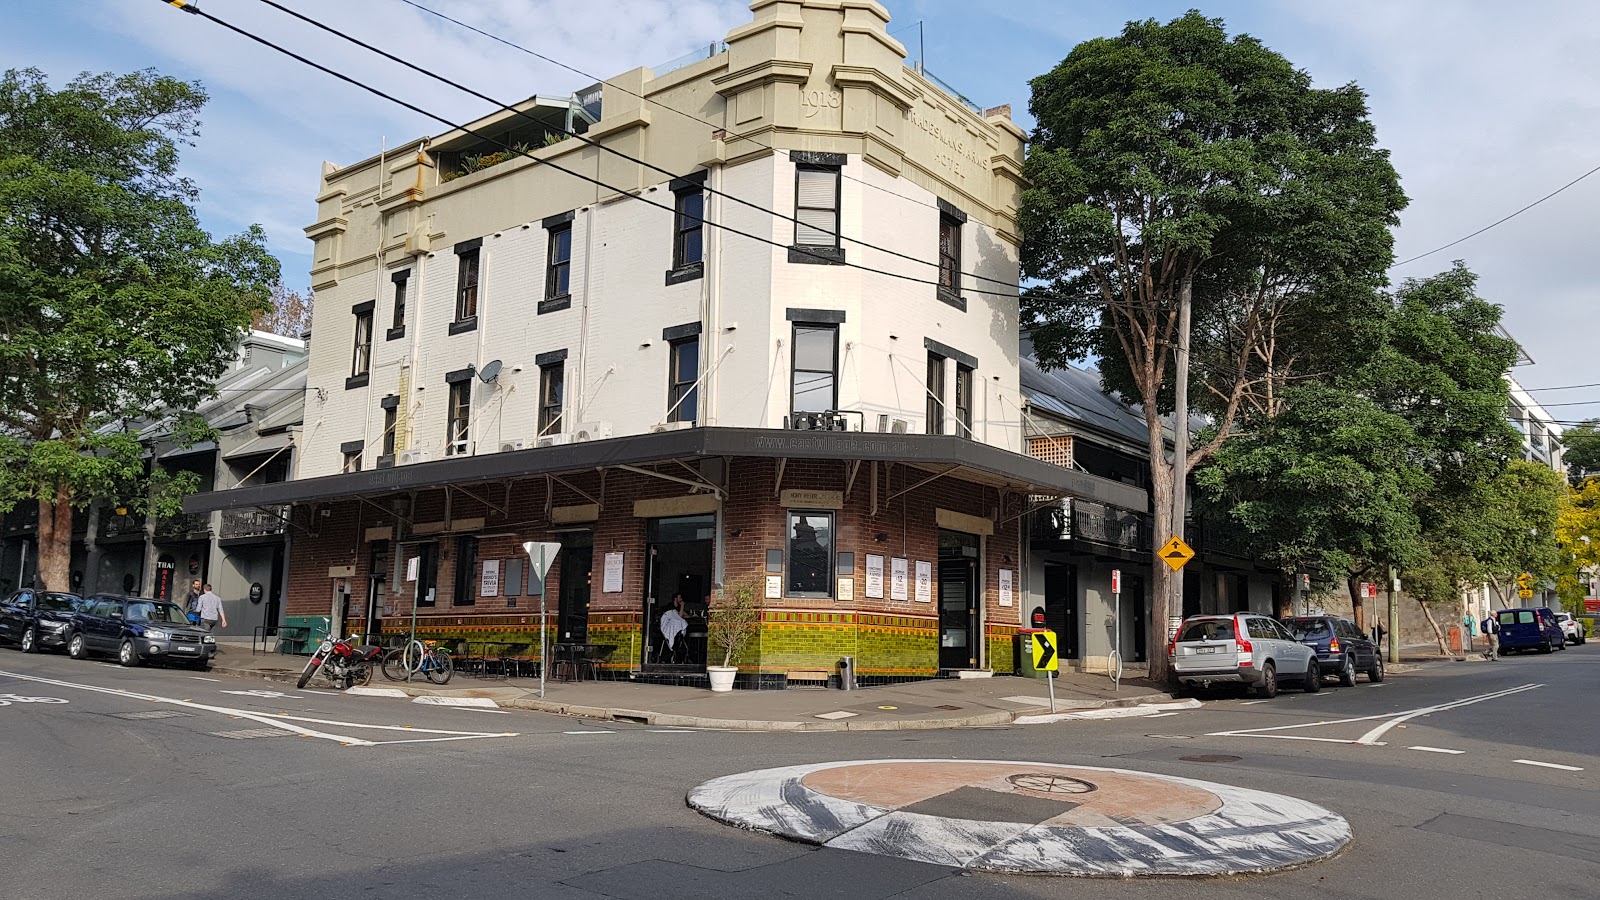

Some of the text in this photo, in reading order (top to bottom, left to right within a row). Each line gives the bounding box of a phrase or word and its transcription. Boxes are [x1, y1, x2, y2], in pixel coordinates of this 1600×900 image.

[801, 90, 841, 118] 1918
[933, 153, 966, 179] HOTEL
[966, 151, 989, 171] ARMS
